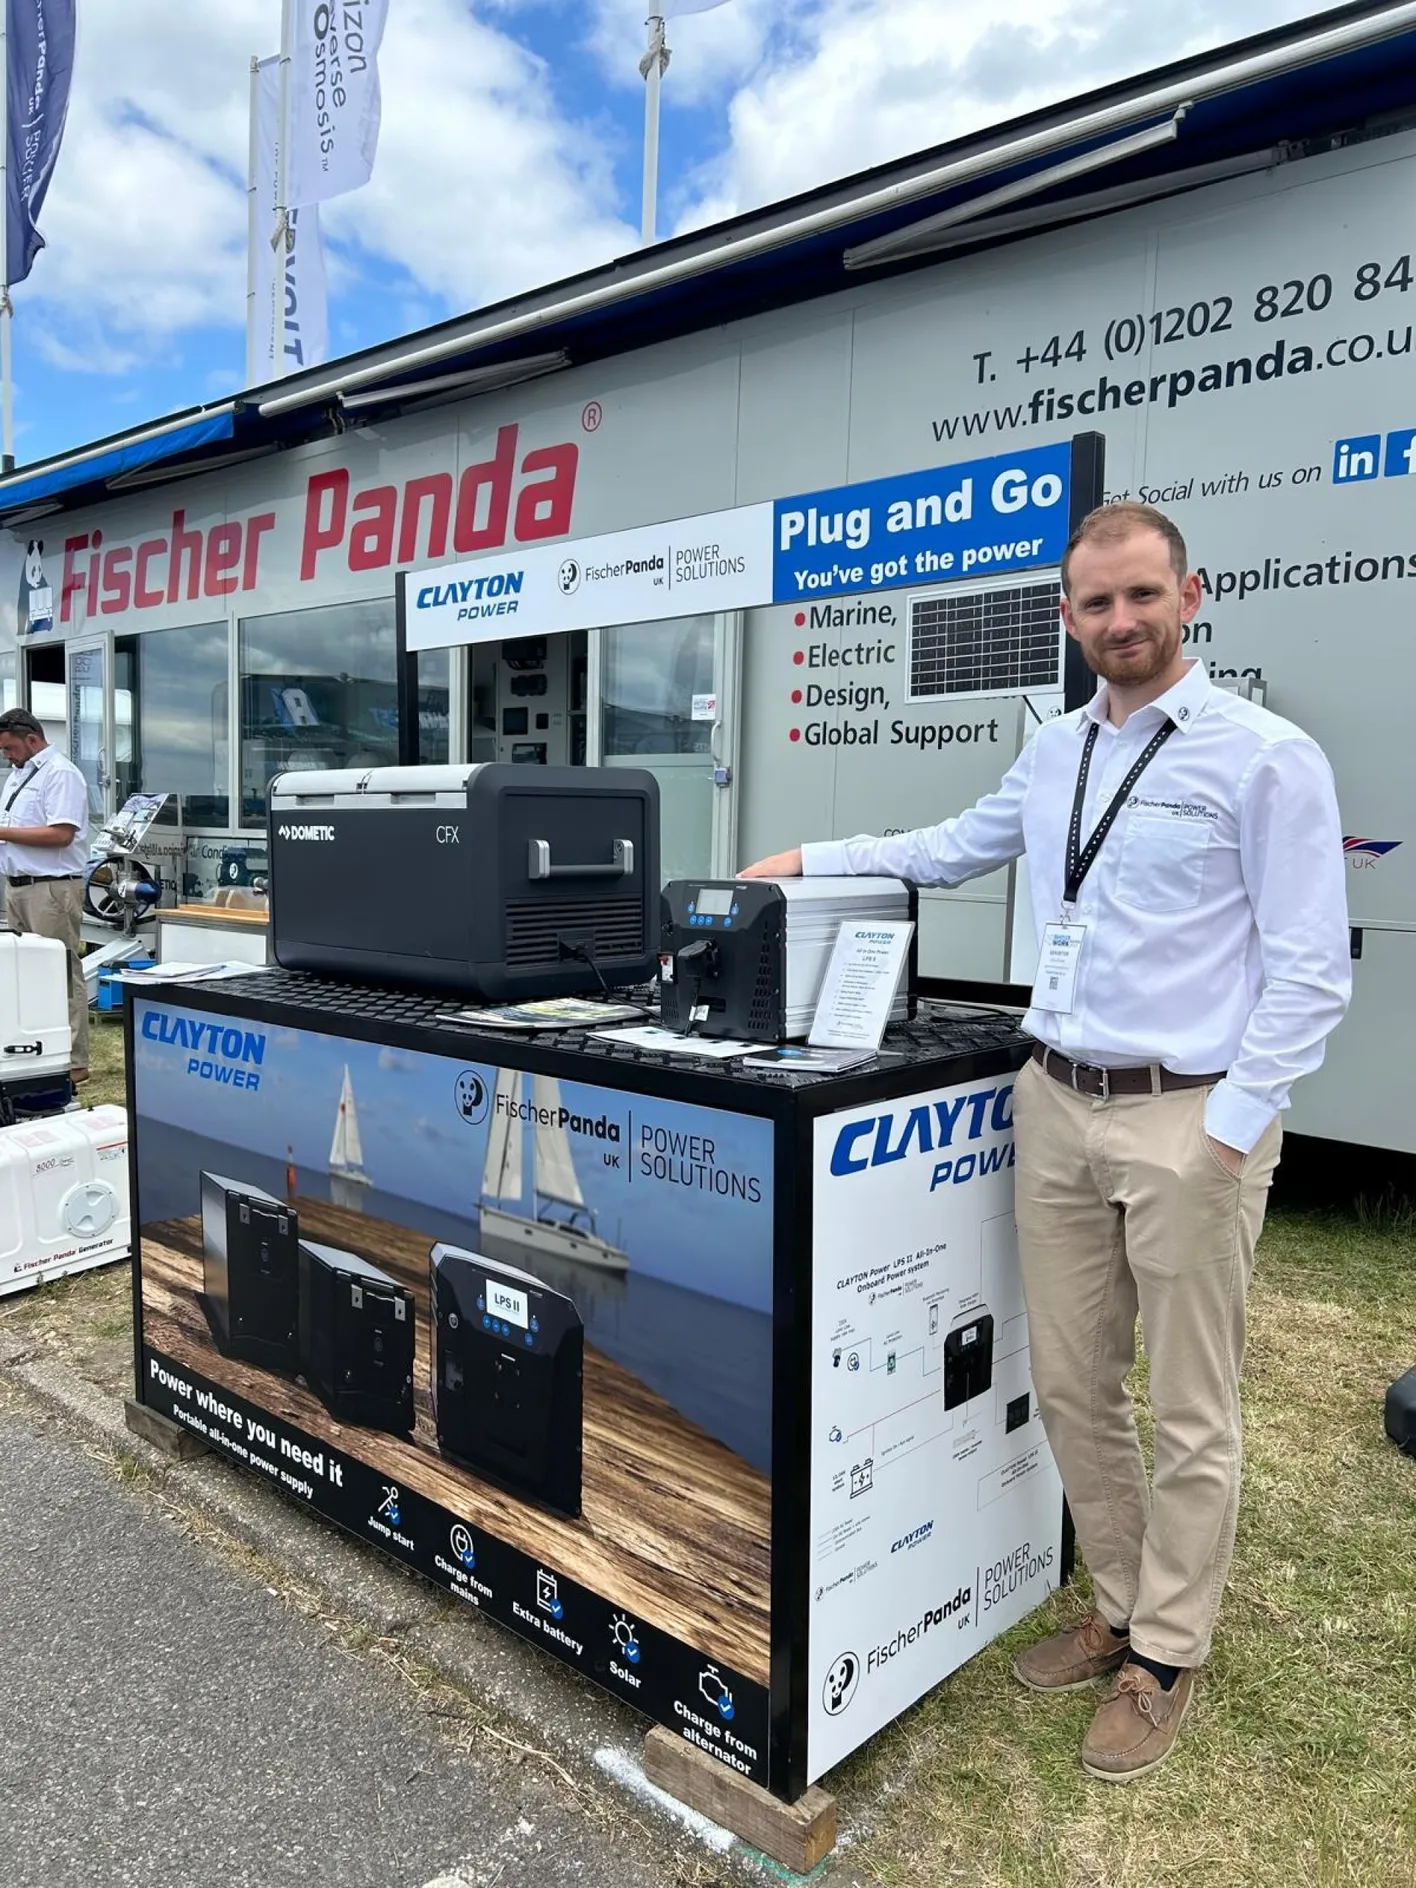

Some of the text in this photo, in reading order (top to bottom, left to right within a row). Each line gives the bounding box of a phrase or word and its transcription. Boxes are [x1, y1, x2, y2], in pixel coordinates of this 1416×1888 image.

[973, 255, 1414, 385] T. +44 (0)1202 820 84
[1138, 478, 1194, 505] Social
[1201, 471, 1249, 496] with
[1258, 470, 1283, 488] us
[1291, 466, 1322, 484] on
[780, 469, 1062, 550] Plug and Go
[60, 509, 276, 622] Fischer
[586, 555, 664, 581] FischerPanda
[676, 544, 720, 565] POWER
[676, 557, 745, 583] SOLUTIONS
[870, 555, 908, 584] got
[915, 551, 954, 573] the
[962, 538, 1043, 571] power
[416, 571, 524, 609] CLAYTON
[653, 577, 664, 586] UK
[457, 601, 518, 621] POWER
[809, 601, 898, 629] Marine,
[808, 639, 896, 668] Electric
[806, 682, 890, 712] Design,
[804, 718, 999, 750] Global Support
[291, 826, 335, 841] DOMETIC
[435, 825, 460, 844] CFX
[1352, 858, 1377, 869] UK
[141, 1010, 267, 1065] CLAYTON
[187, 1058, 260, 1091] POWER
[496, 1094, 621, 1143] FischerPanda
[830, 1085, 1014, 1177] CLAYTO
[603, 1152, 620, 1169] UK
[641, 1124, 716, 1164] POWER
[641, 1152, 762, 1203] SOLUTIONS
[23, 1238, 114, 1271] Fischer Panda Generator
[836, 1270, 869, 1290] CLAYTON
[869, 1264, 891, 1277] Power
[857, 1260, 930, 1293] Onboard Power system
[494, 1292, 512, 1309] LPS
[513, 1299, 520, 1312] II
[150, 1358, 343, 1487] Power where you need it
[173, 1403, 314, 1499] Portable all-in-one power supply
[367, 1515, 415, 1550] Jump start
[890, 1519, 934, 1554] CLAYTON
[434, 1555, 493, 1598] Charge from
[984, 1541, 1031, 1590] POWER
[984, 1546, 1054, 1611] SOLUTIONS
[450, 1581, 479, 1606] mains
[512, 1601, 583, 1656] Extra battery
[866, 1586, 971, 1674] FischerPanda
[957, 1614, 971, 1630] UK
[608, 1661, 641, 1689] Solar
[673, 1700, 757, 1761] Charge from
[682, 1725, 751, 1776] alternator
